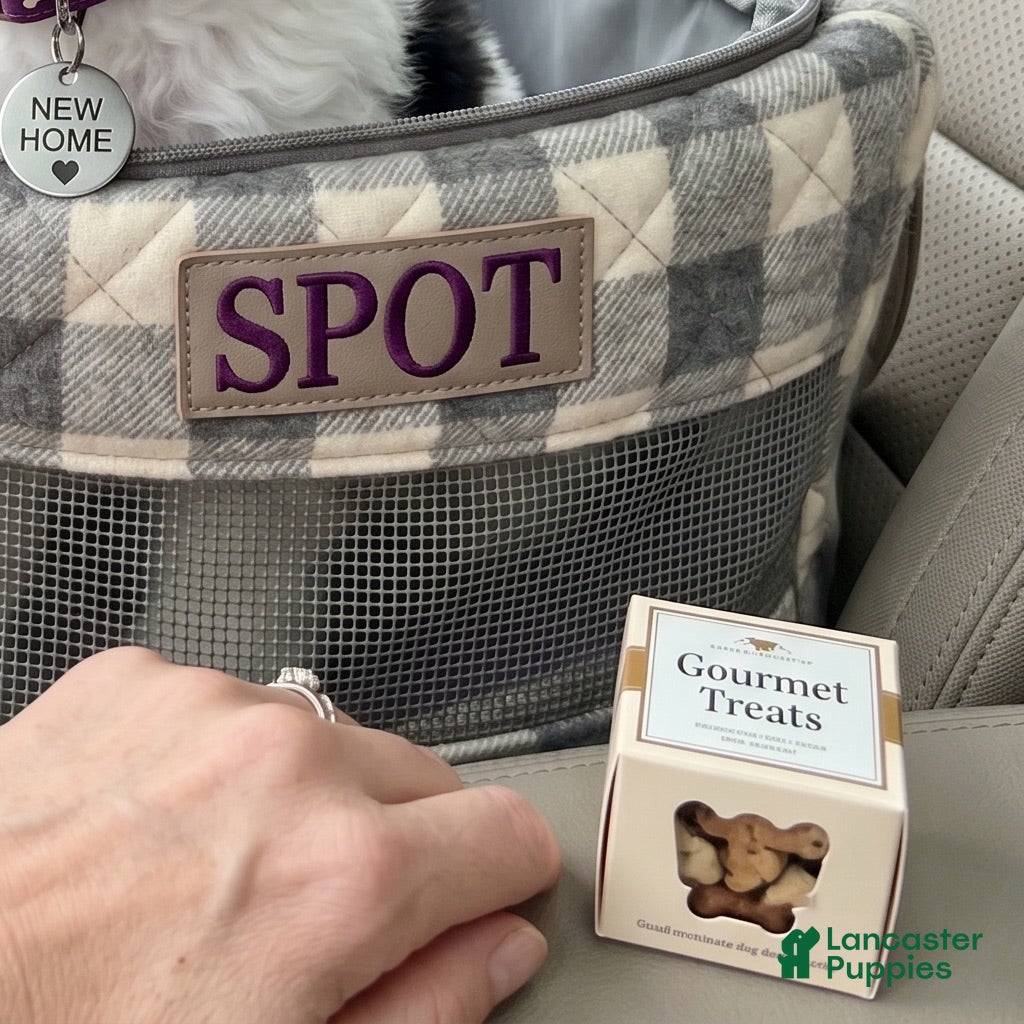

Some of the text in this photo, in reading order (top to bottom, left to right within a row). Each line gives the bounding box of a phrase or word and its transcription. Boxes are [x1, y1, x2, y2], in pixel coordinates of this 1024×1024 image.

[32, 97, 103, 121] NEW
[20, 127, 112, 152] HOME
[216, 248, 562, 394] SPOT
[677, 652, 849, 705] Gourmet
[699, 686, 823, 731] Treats
